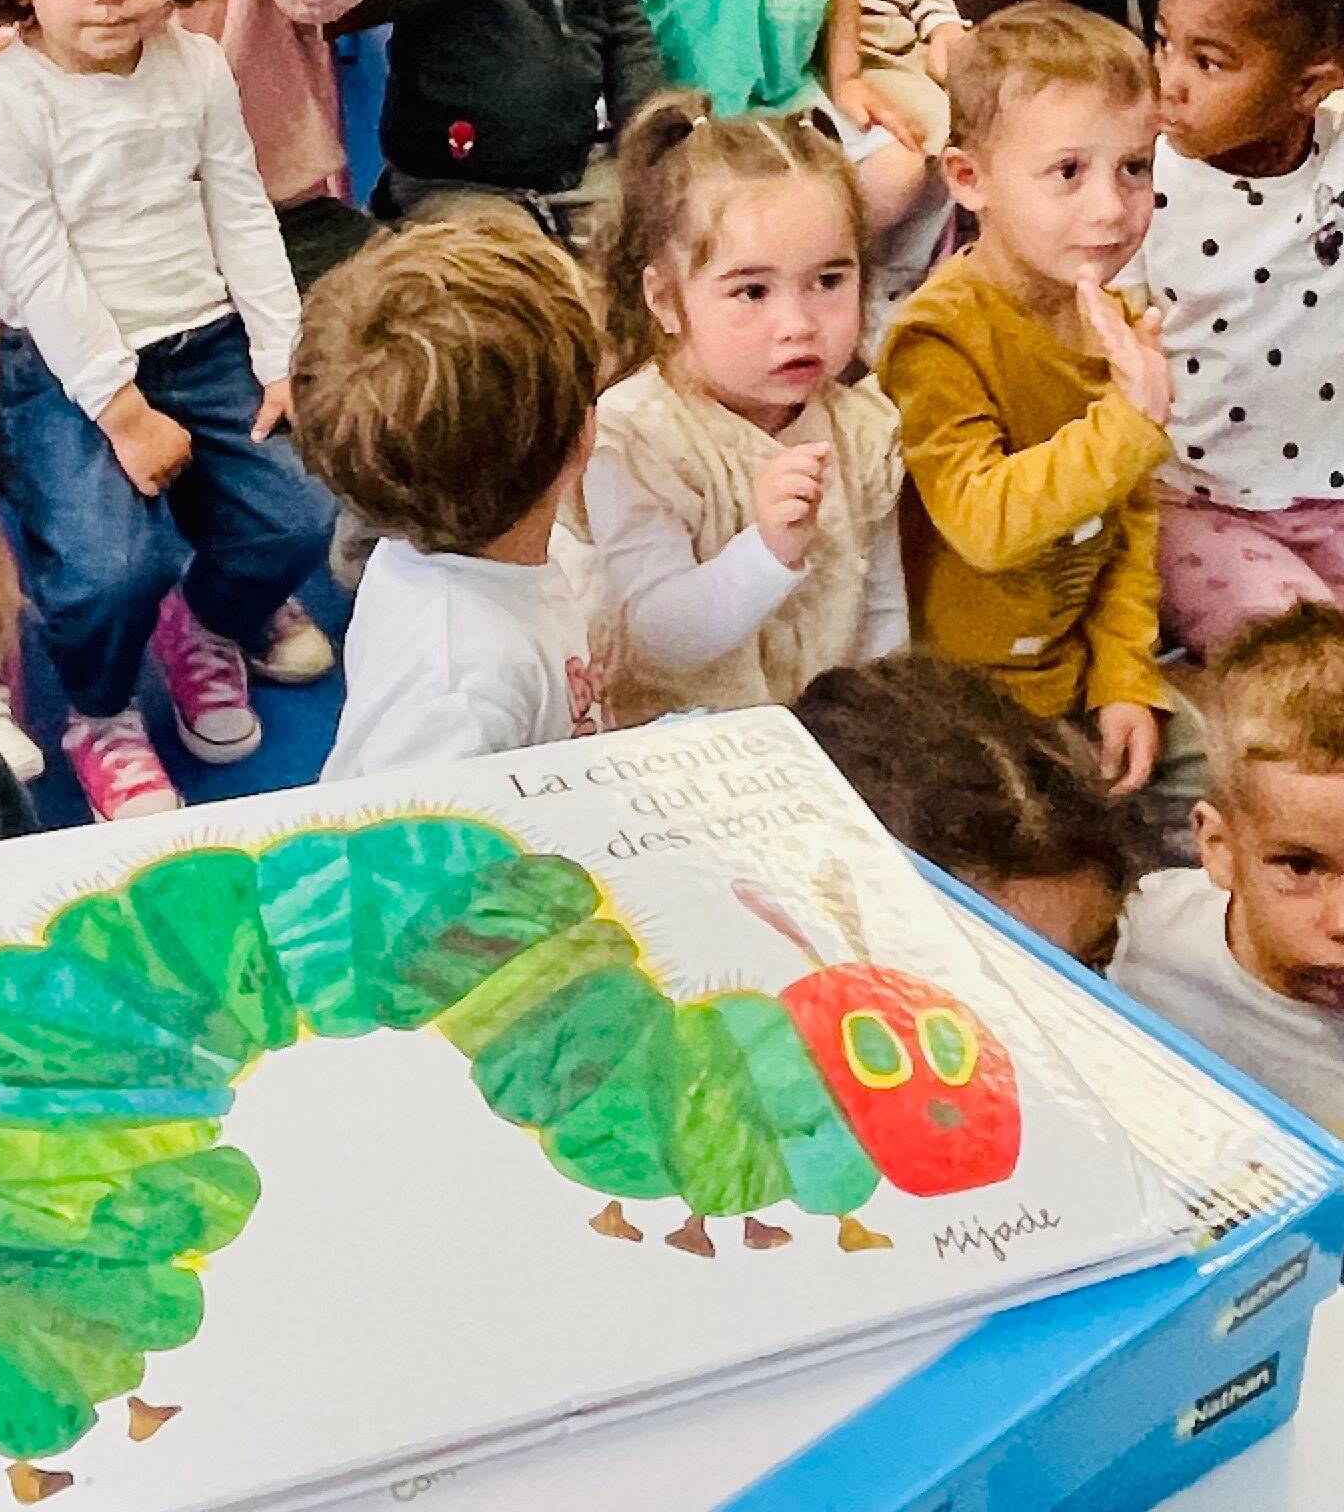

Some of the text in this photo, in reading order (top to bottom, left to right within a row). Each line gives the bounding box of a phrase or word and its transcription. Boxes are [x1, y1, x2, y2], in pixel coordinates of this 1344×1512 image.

[508, 733, 770, 798] La chenille
[630, 777, 710, 820] qui
[607, 827, 692, 860] des
[932, 1201, 1062, 1262] Mijade
